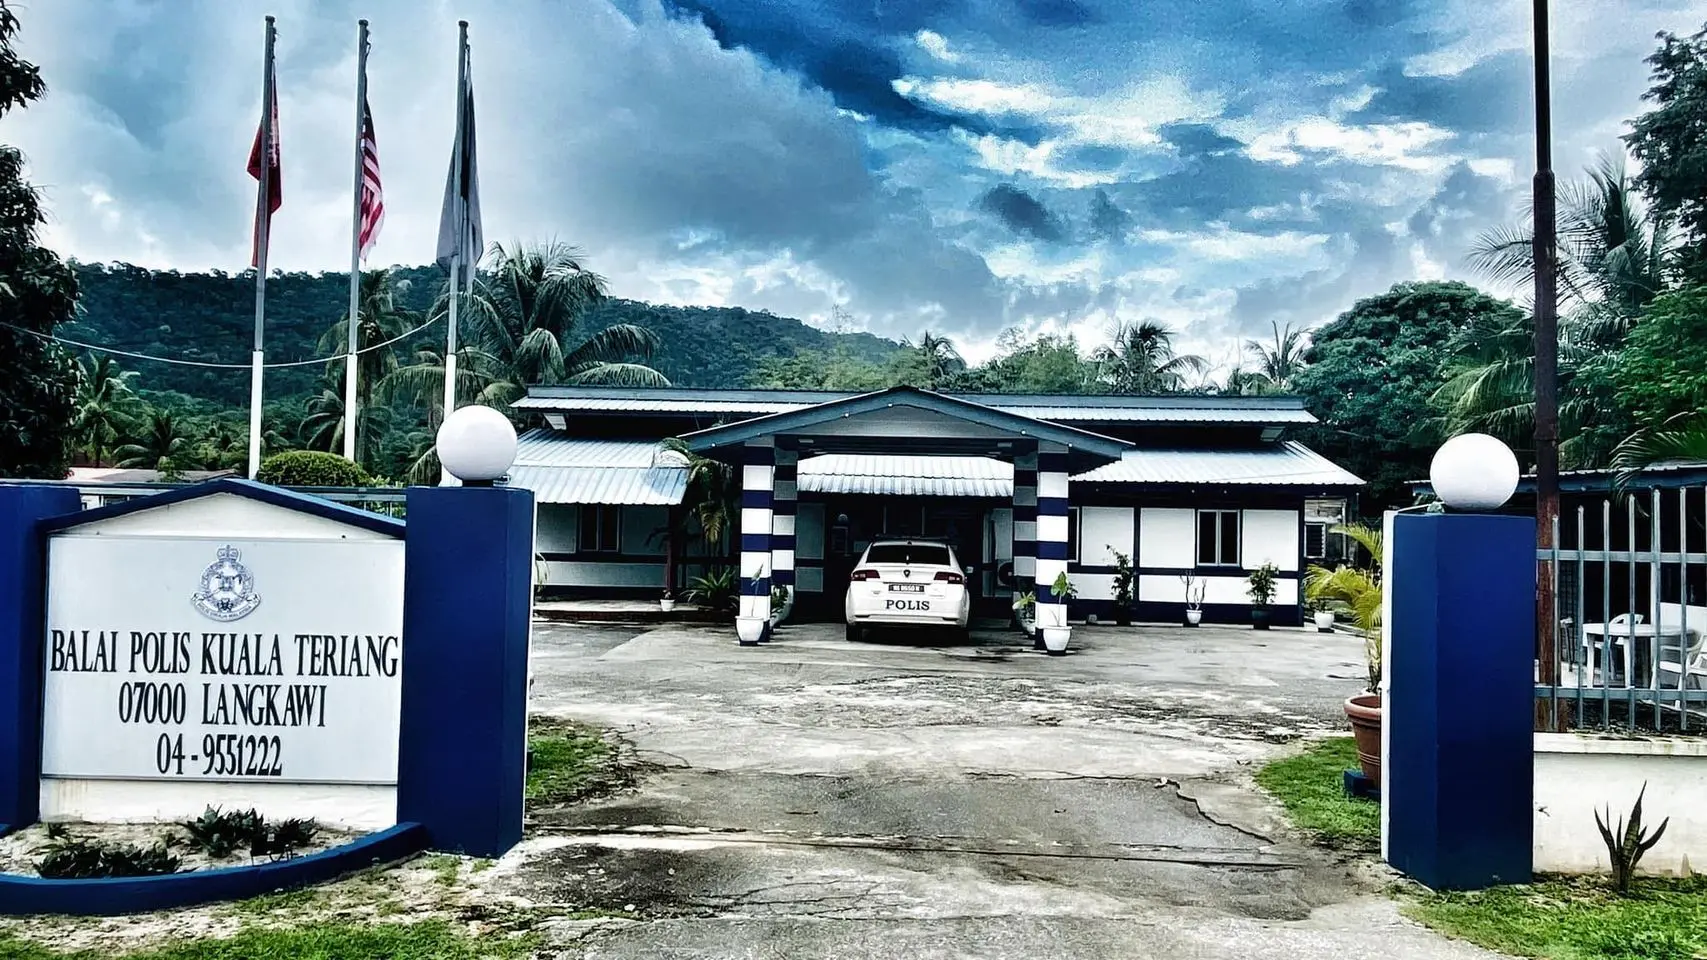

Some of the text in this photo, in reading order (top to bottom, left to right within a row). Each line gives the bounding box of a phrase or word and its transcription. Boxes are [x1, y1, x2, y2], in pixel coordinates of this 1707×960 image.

[886, 599, 930, 611] POLIS
[50, 629, 398, 678] BALAI POLIS KUALA TERIANG
[118, 681, 327, 727] 07000 LANGKAWI
